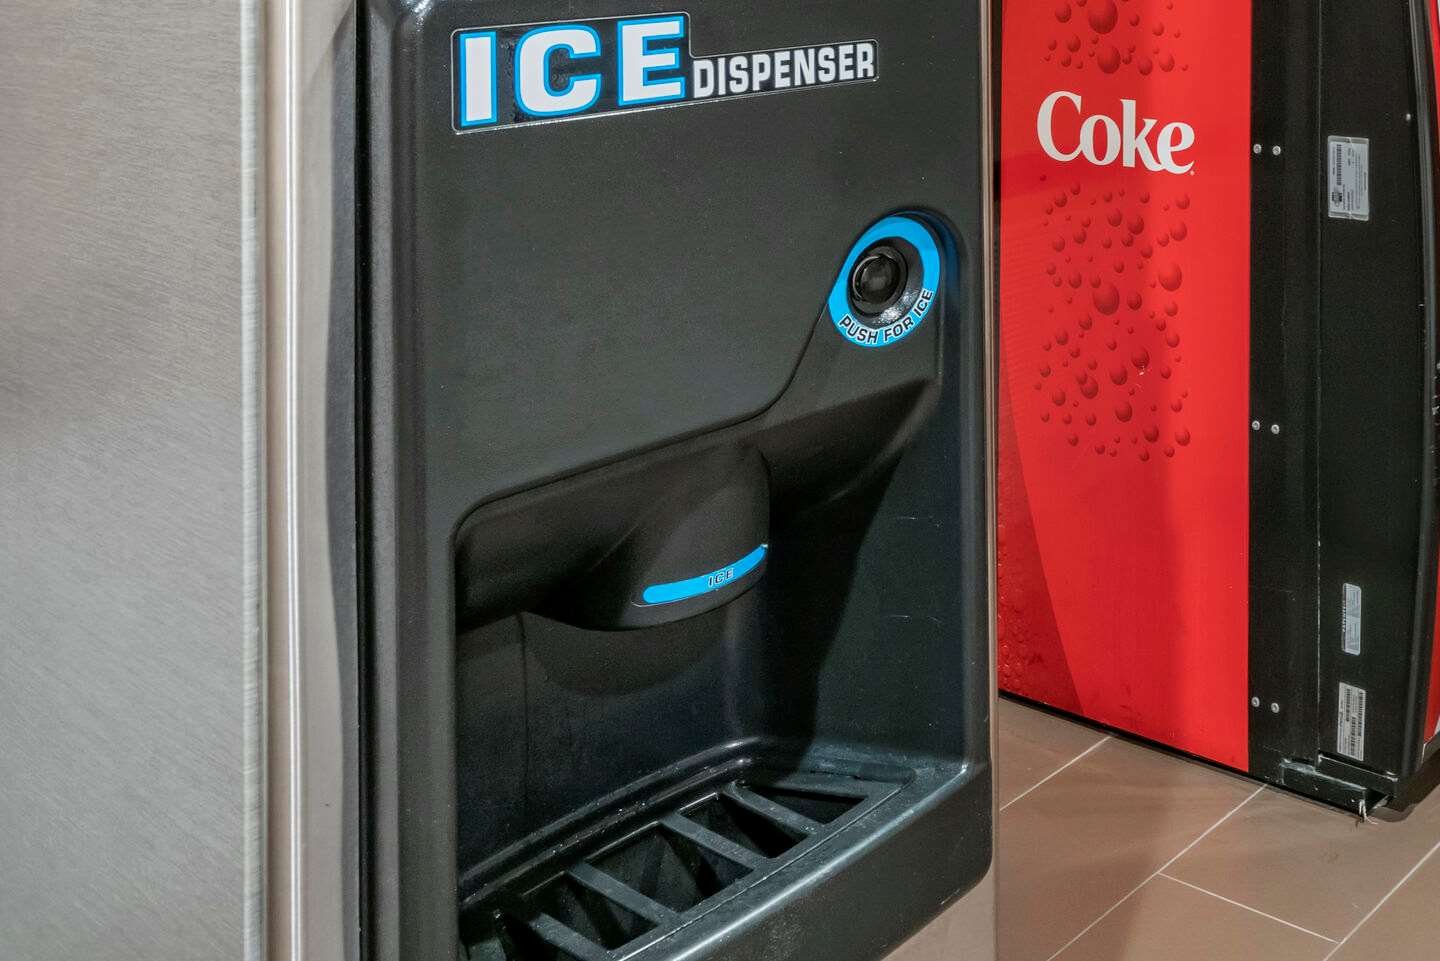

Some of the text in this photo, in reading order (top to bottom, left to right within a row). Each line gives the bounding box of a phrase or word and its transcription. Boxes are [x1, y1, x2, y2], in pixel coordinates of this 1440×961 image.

[458, 14, 876, 128] ICE DISPENSER
[1036, 90, 1196, 175] Coke
[839, 288, 934, 344] PUSH FOR ICE
[707, 567, 734, 588] ICE
